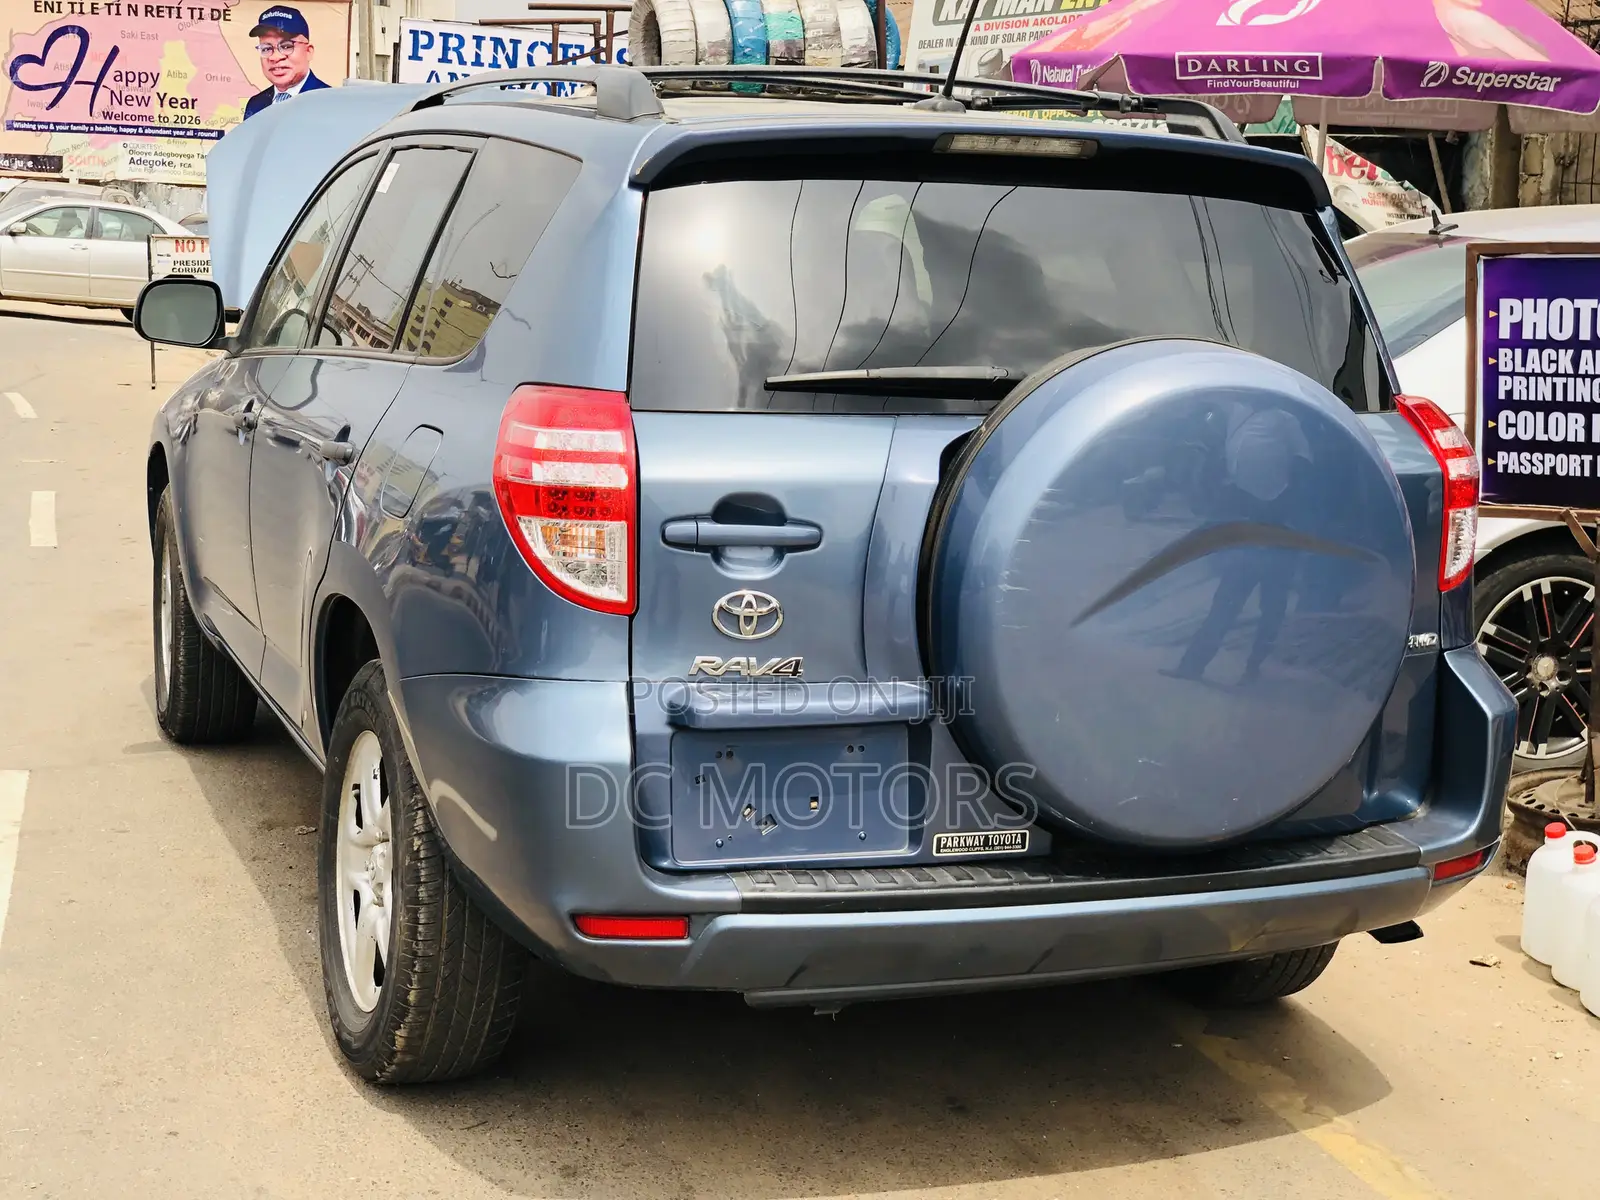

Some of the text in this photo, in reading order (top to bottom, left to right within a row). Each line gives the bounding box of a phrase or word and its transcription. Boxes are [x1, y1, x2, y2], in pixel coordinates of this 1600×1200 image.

[34, 1, 62, 13] ENI
[262, 11, 292, 20] Solutions
[974, 23, 981, 32] A
[984, 18, 1029, 31] DIVISION
[918, 39, 944, 49] DEALER
[946, 37, 954, 47] IN
[970, 34, 988, 46] KIND
[989, 33, 1000, 44] OF
[1001, 32, 1027, 44] SOLAR
[1187, 58, 1310, 73] DARLING
[1043, 65, 1075, 83] Natural
[1452, 66, 1561, 92] Superstar
[1207, 79, 1300, 88] FindYourBeautiful
[110, 90, 198, 109] New Year
[102, 110, 154, 122] Welcome
[158, 114, 169, 124] to
[173, 114, 201, 125] 2026
[13, 121, 36, 130] Wishing
[71, 124, 89, 132] family
[119, 126, 137, 134] happy
[129, 157, 176, 168] Adegoke,
[1499, 298, 1600, 341] PHOT
[1498, 348, 1574, 375] BLACK
[1498, 410, 1585, 443] COLOR
[1497, 451, 1592, 477] PASSPORT
[688, 656, 804, 678] RAV4
[940, 834, 1021, 848] PARKWAY TOYOTA
